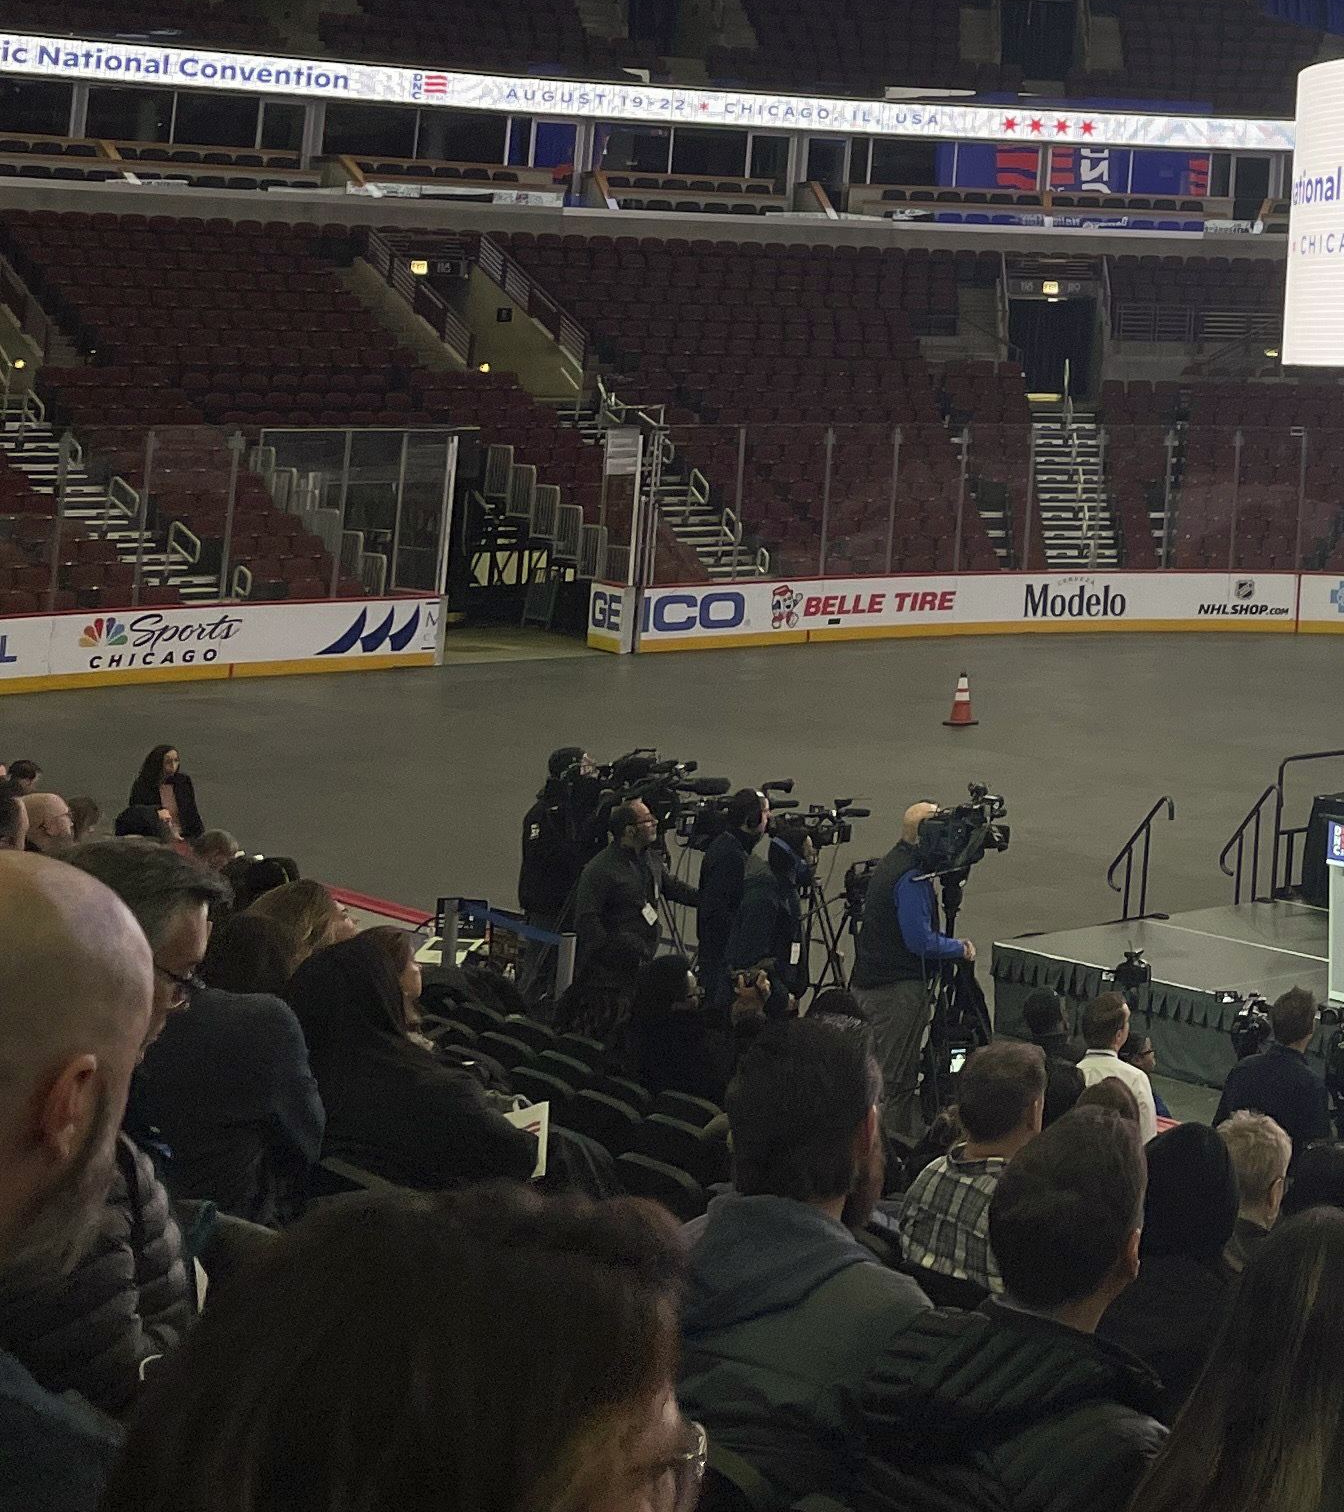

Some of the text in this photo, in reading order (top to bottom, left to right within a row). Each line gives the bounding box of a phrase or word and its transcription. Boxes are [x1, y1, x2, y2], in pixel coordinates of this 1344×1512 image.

[37, 44, 171, 77] National
[179, 56, 351, 90] Convention
[505, 86, 608, 108] AUGUST
[620, 94, 687, 112] 19-22
[895, 112, 941, 127] USA
[803, 589, 958, 618] BELLE TIRE
[1023, 583, 1127, 619] Modelo
[127, 611, 243, 651] Sports
[88, 646, 219, 670] CHICAGO
